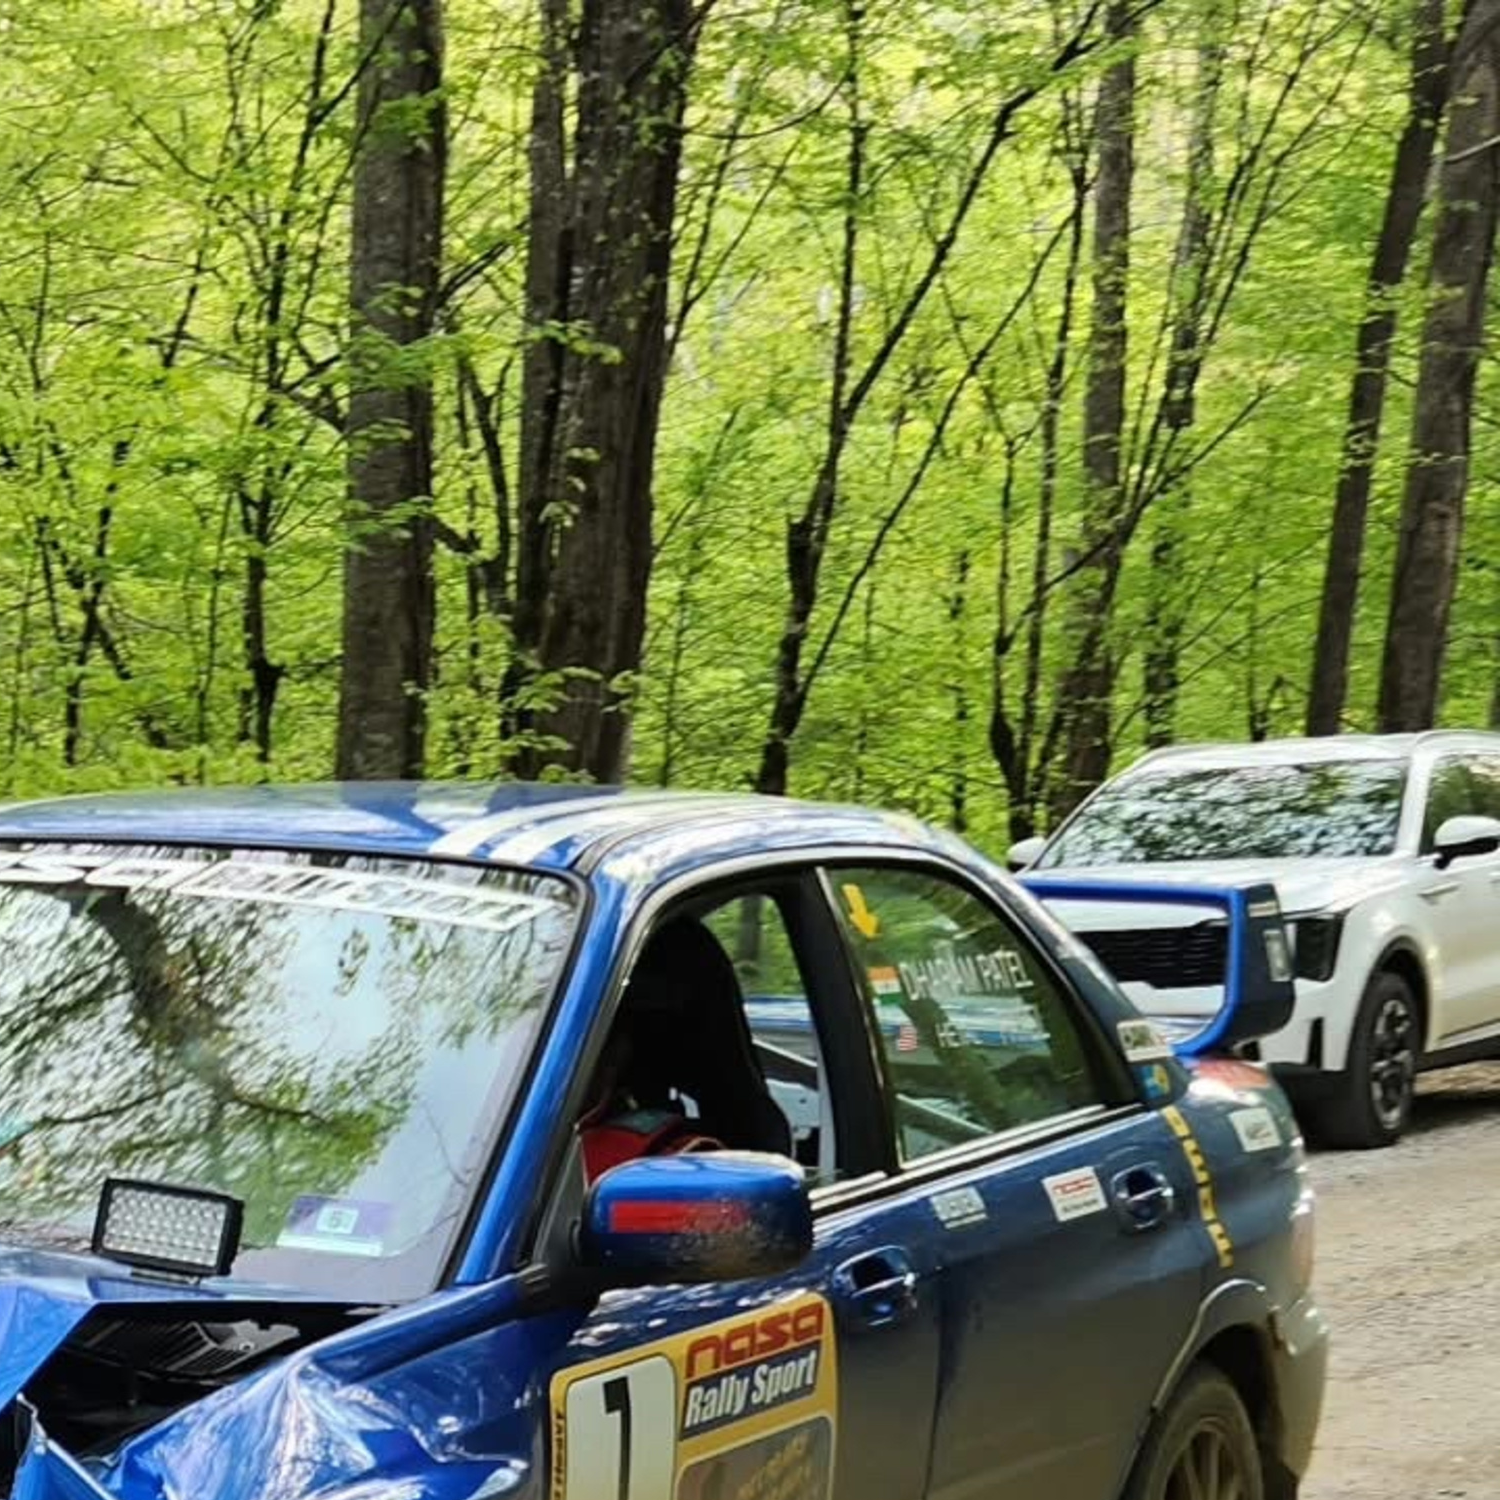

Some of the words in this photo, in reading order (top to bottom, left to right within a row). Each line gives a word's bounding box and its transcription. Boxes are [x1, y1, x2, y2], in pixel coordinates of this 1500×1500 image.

[684, 1301, 824, 1380] nasa
[684, 1374, 749, 1428] Rally
[751, 1350, 817, 1404] Sport
